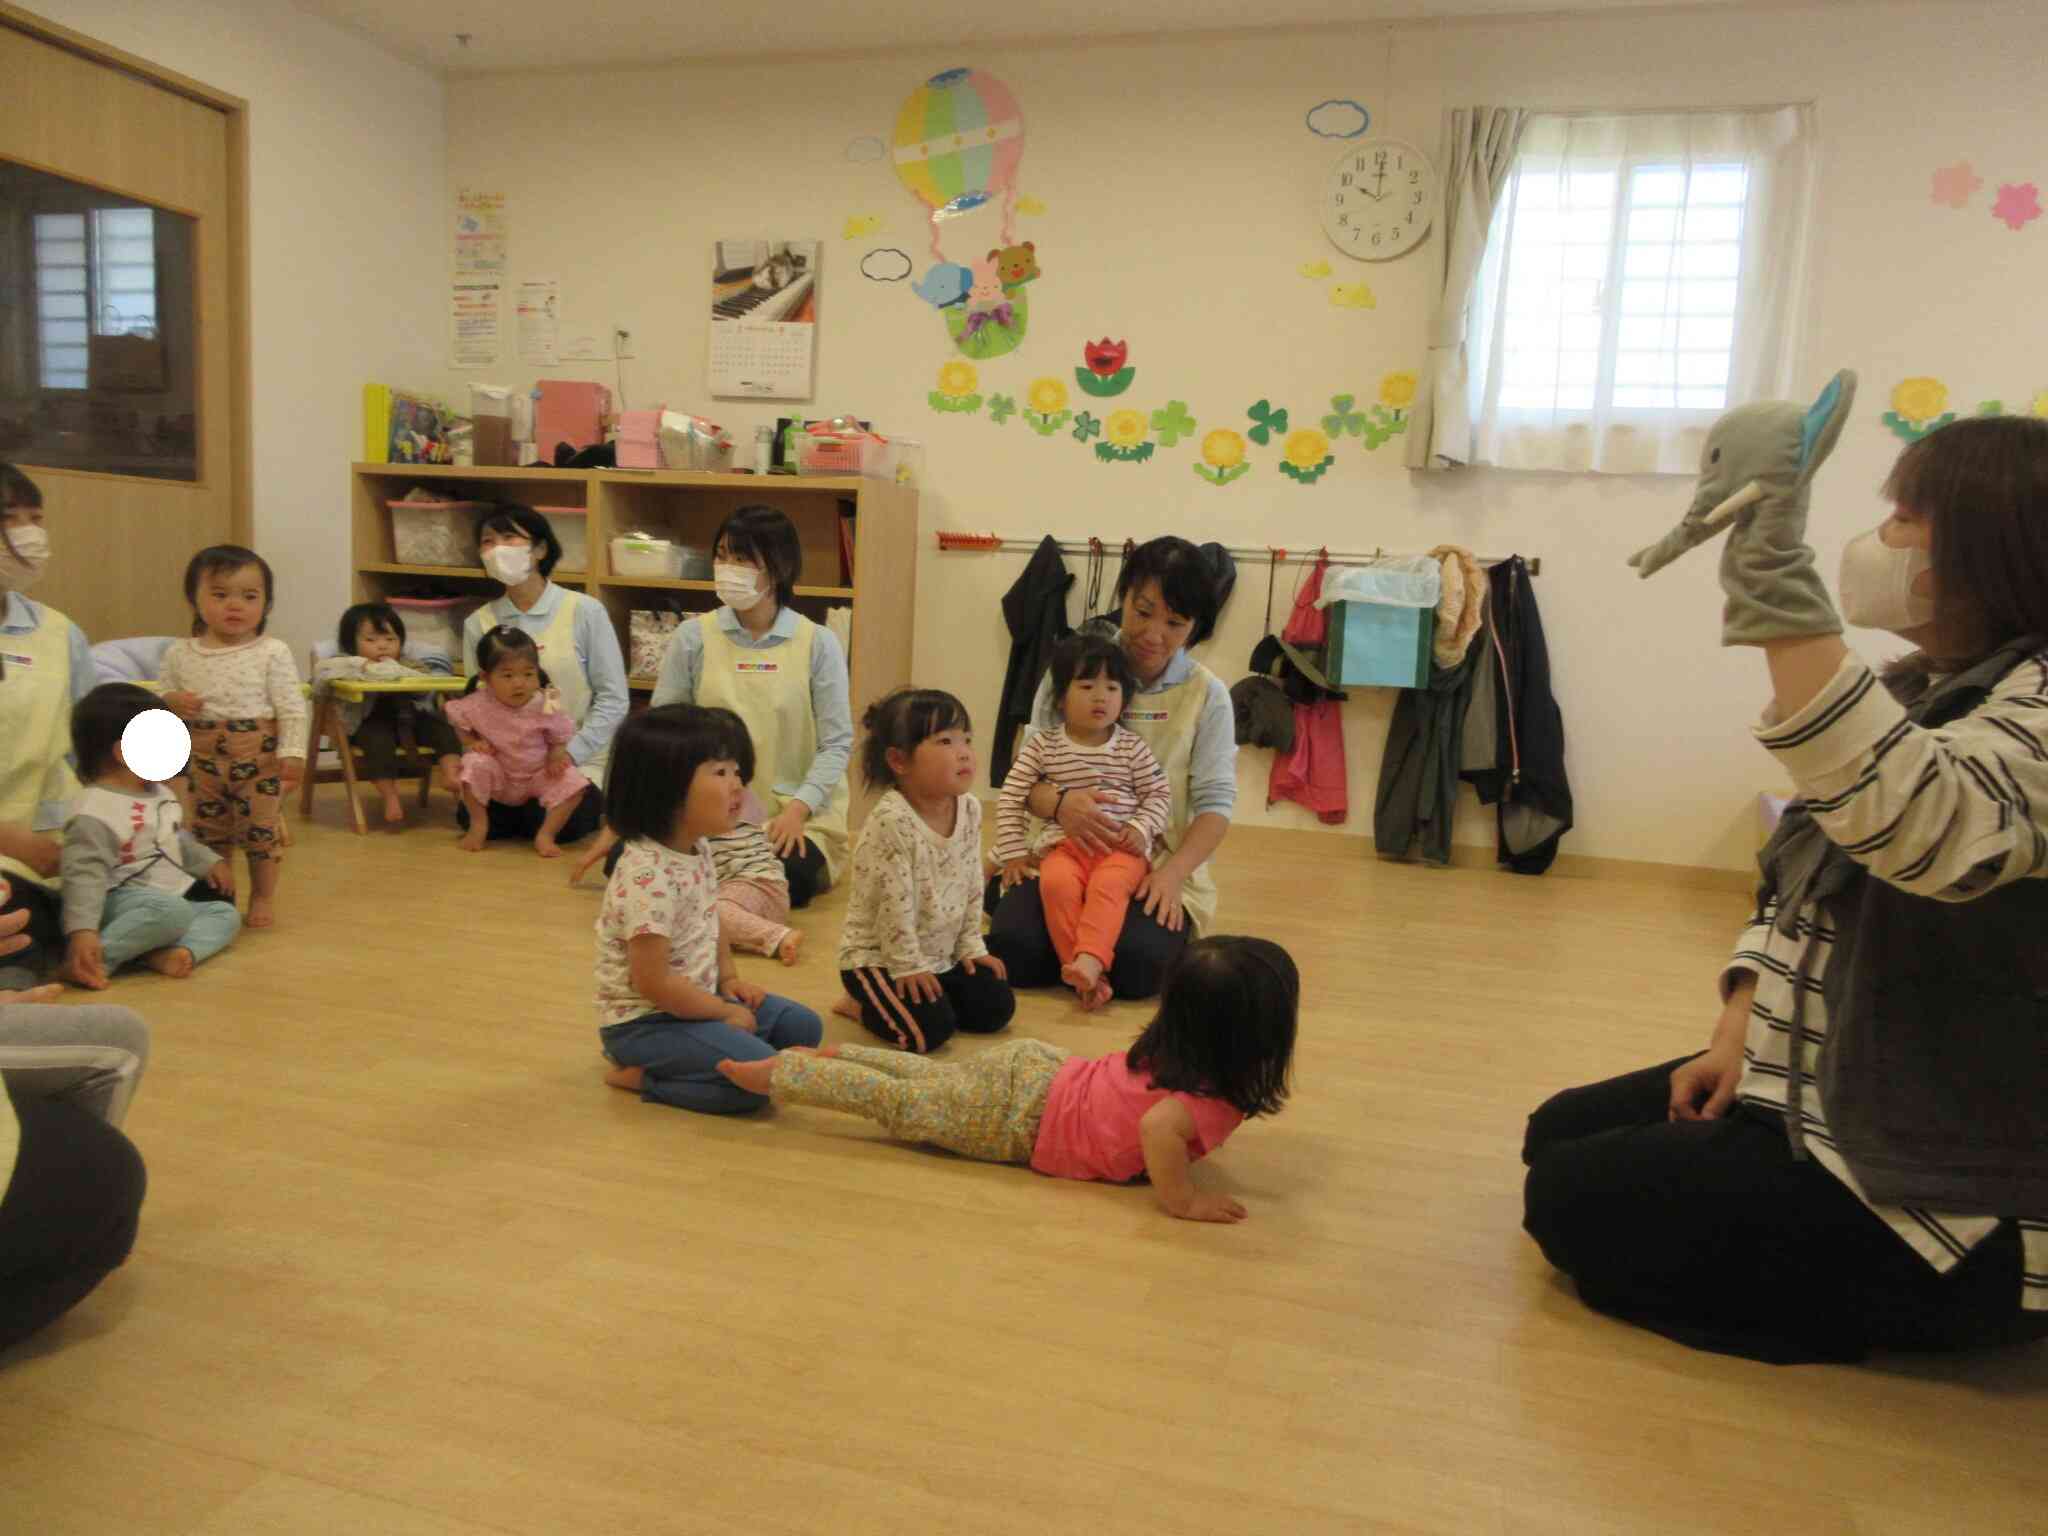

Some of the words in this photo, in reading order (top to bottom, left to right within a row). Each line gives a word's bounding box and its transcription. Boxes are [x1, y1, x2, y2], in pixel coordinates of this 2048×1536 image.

[1356, 157, 1365, 171] 11
[1374, 151, 1387, 165] 12
[1397, 155, 1402, 170] 1
[1342, 173, 1352, 187] 10
[1409, 171, 1418, 184] 2
[1336, 193, 1344, 207] 9
[1338, 214, 1348, 225] 8
[1353, 228, 1361, 241] 7
[1371, 231, 1381, 245] 6
[1392, 227, 1400, 240] 5
